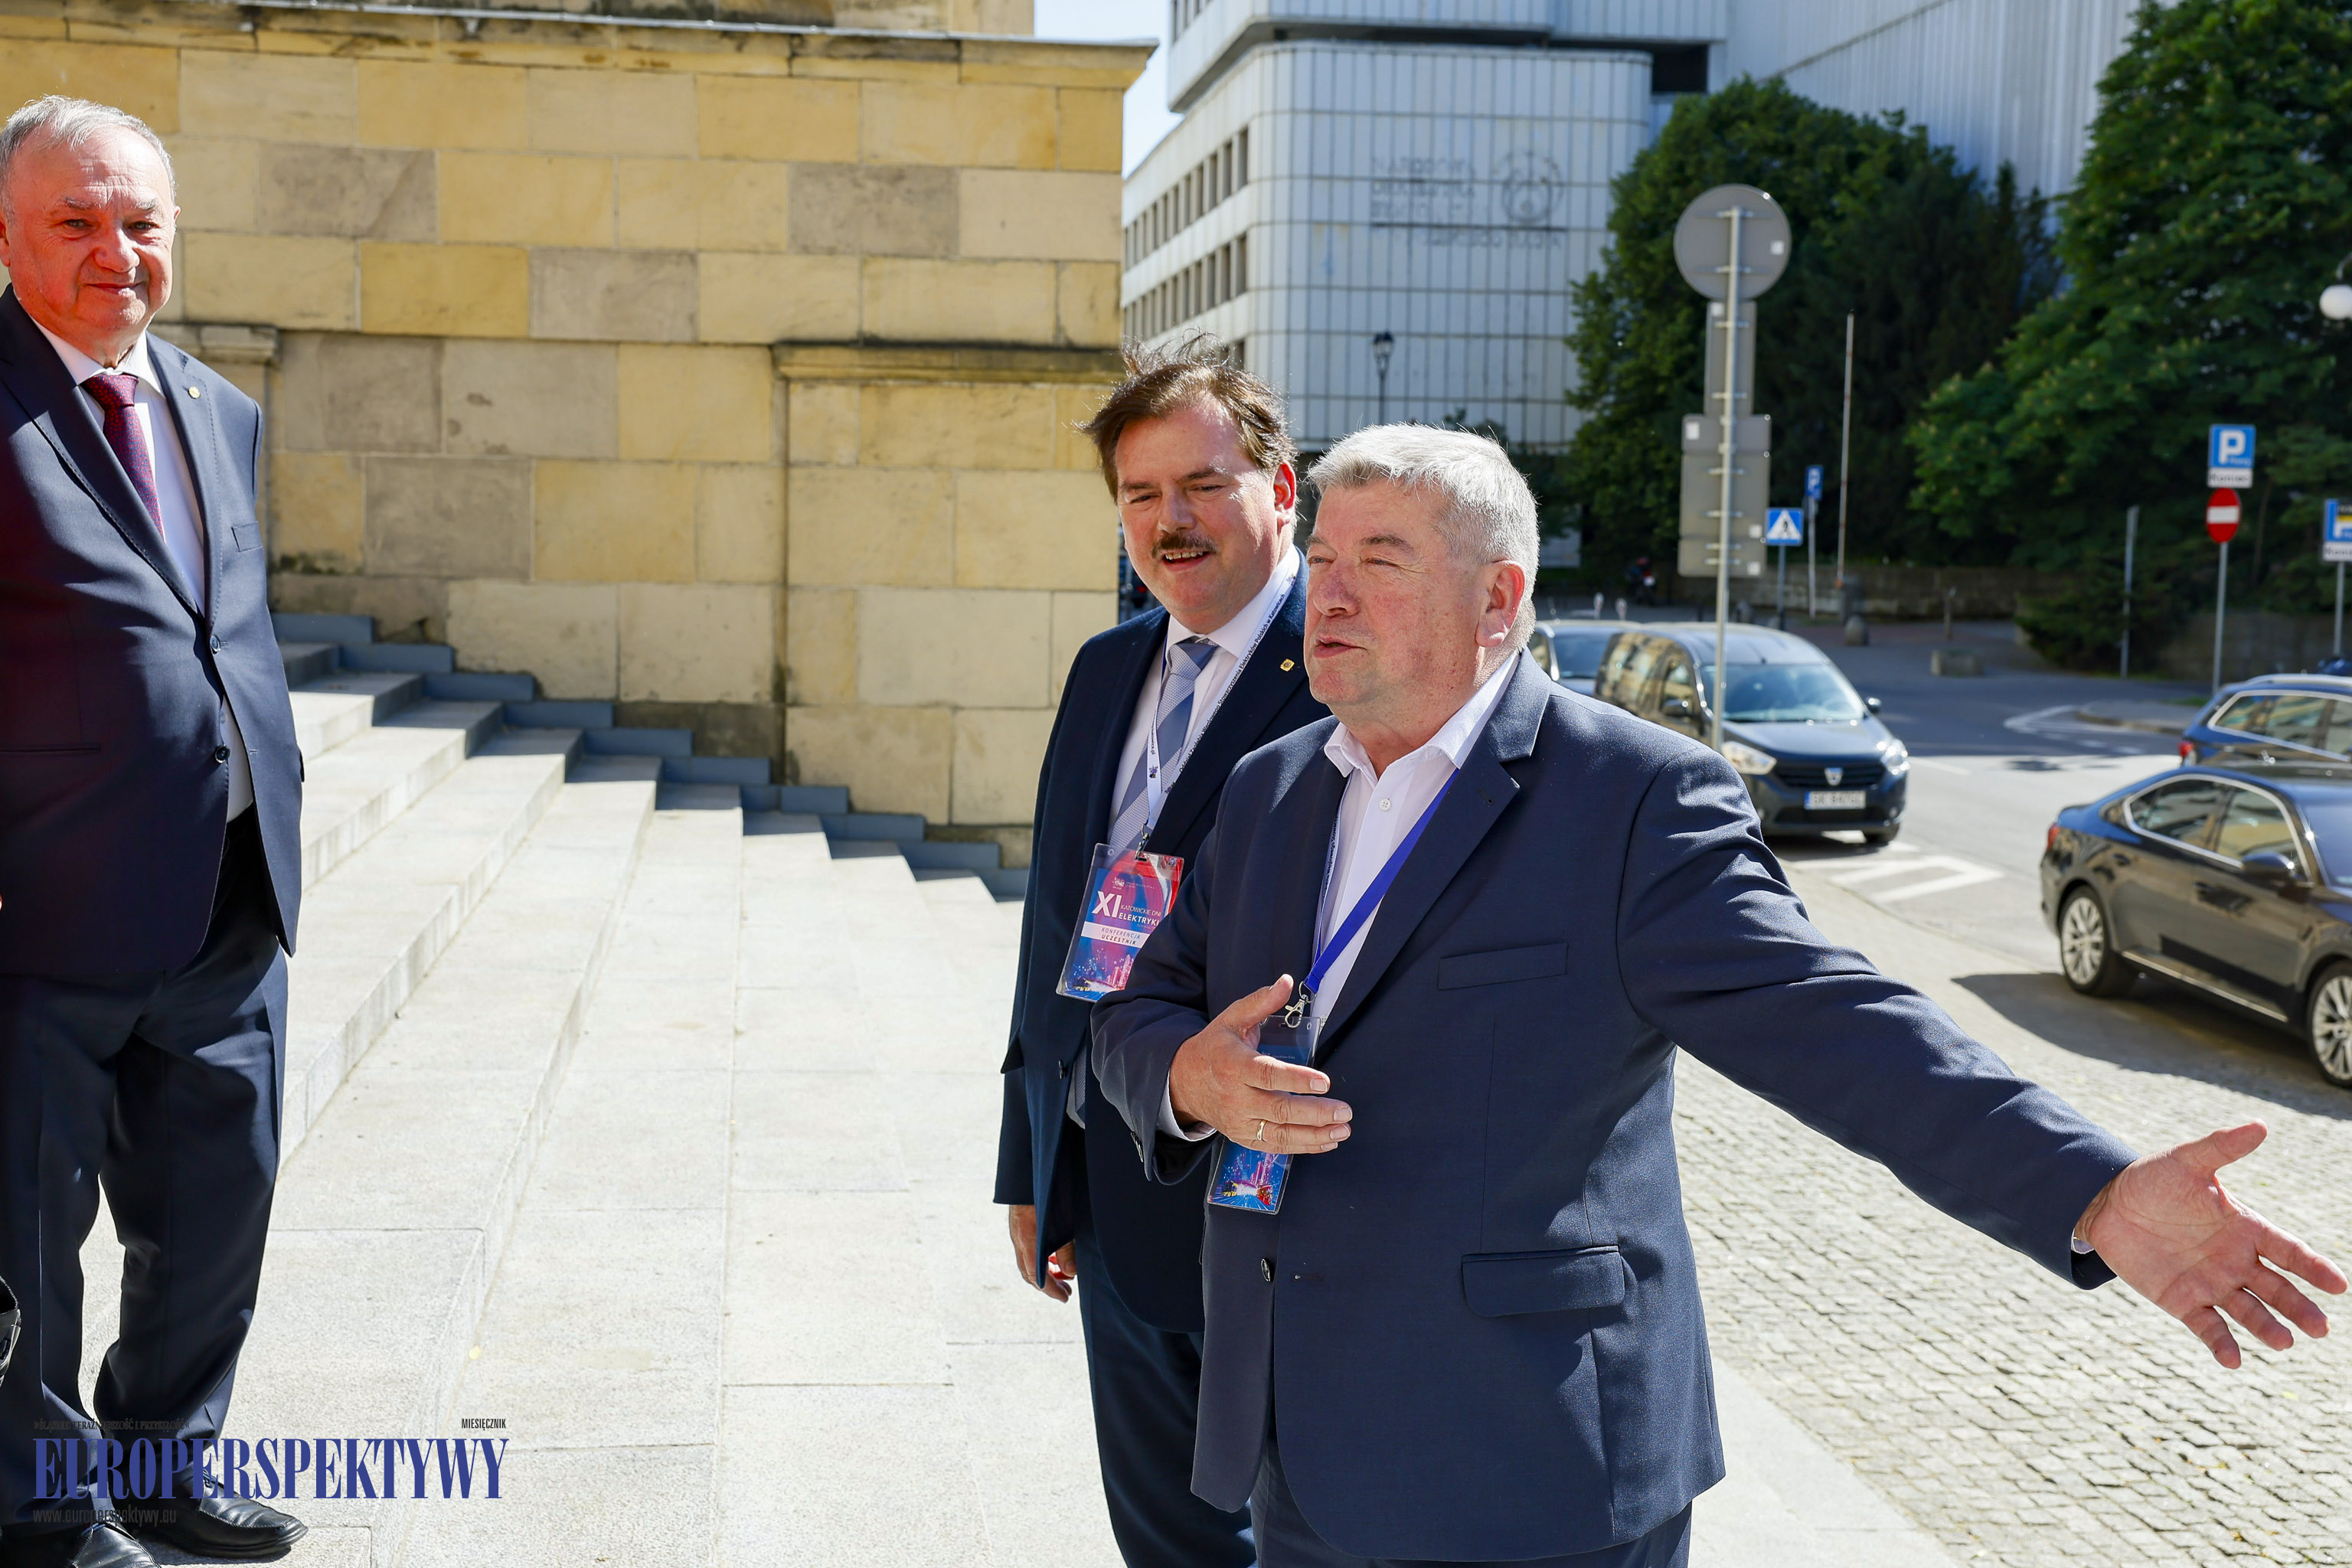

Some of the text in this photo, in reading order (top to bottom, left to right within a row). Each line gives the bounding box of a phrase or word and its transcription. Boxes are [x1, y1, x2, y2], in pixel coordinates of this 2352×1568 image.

[2220, 430, 2246, 465] P
[1217, 668, 1242, 706] Stowarzyszenia
[1239, 642, 1258, 670] Elektryków
[1254, 623, 1269, 644] Polskich
[1268, 593, 1285, 620] Katowicach
[1091, 890, 1122, 918] XI
[1120, 904, 1151, 915] KATOWICKIE
[1101, 935, 1137, 946] UCZESTNIK
[1102, 928, 1141, 939] KONFERENCJA
